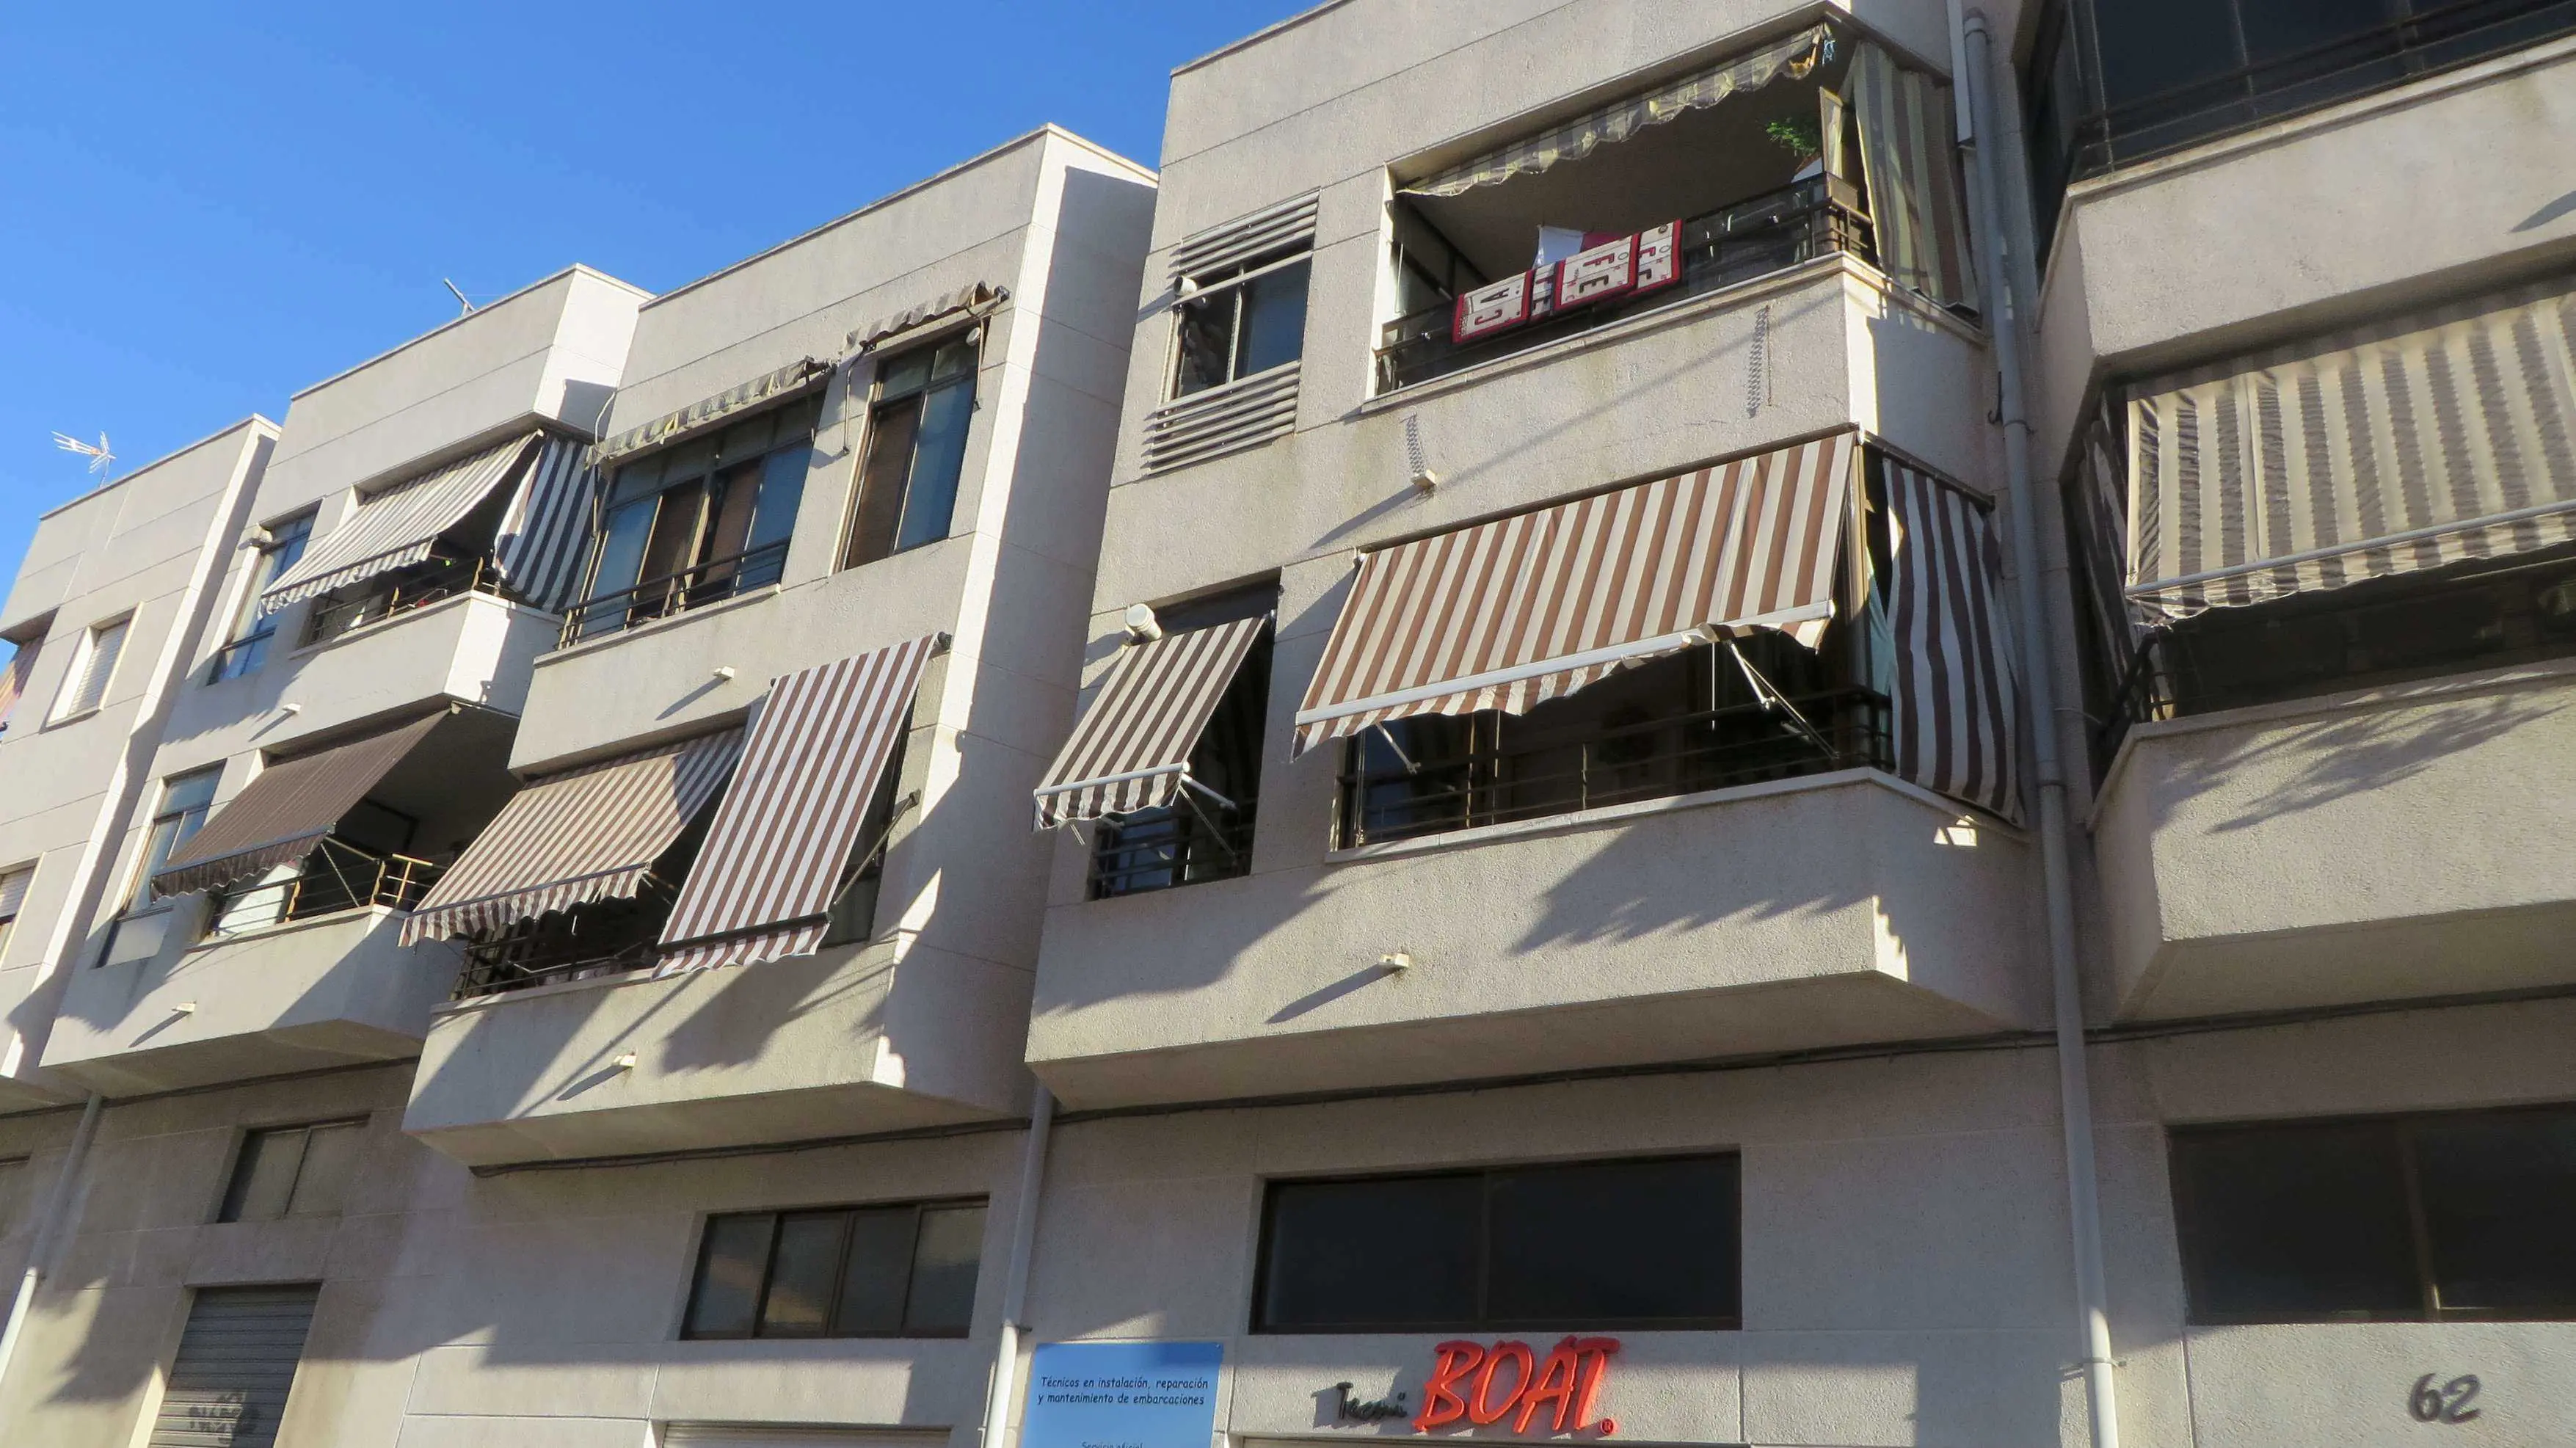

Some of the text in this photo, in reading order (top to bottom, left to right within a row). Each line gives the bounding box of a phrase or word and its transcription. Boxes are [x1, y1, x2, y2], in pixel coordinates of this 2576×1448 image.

[1037, 1393, 1205, 1406] y mantenimiento de embarcaciones
[1041, 1375, 1209, 1391] Técnicos en instalación, reparación
[1411, 1334, 1620, 1433] BOAT
[2408, 1372, 2482, 1425] 62
